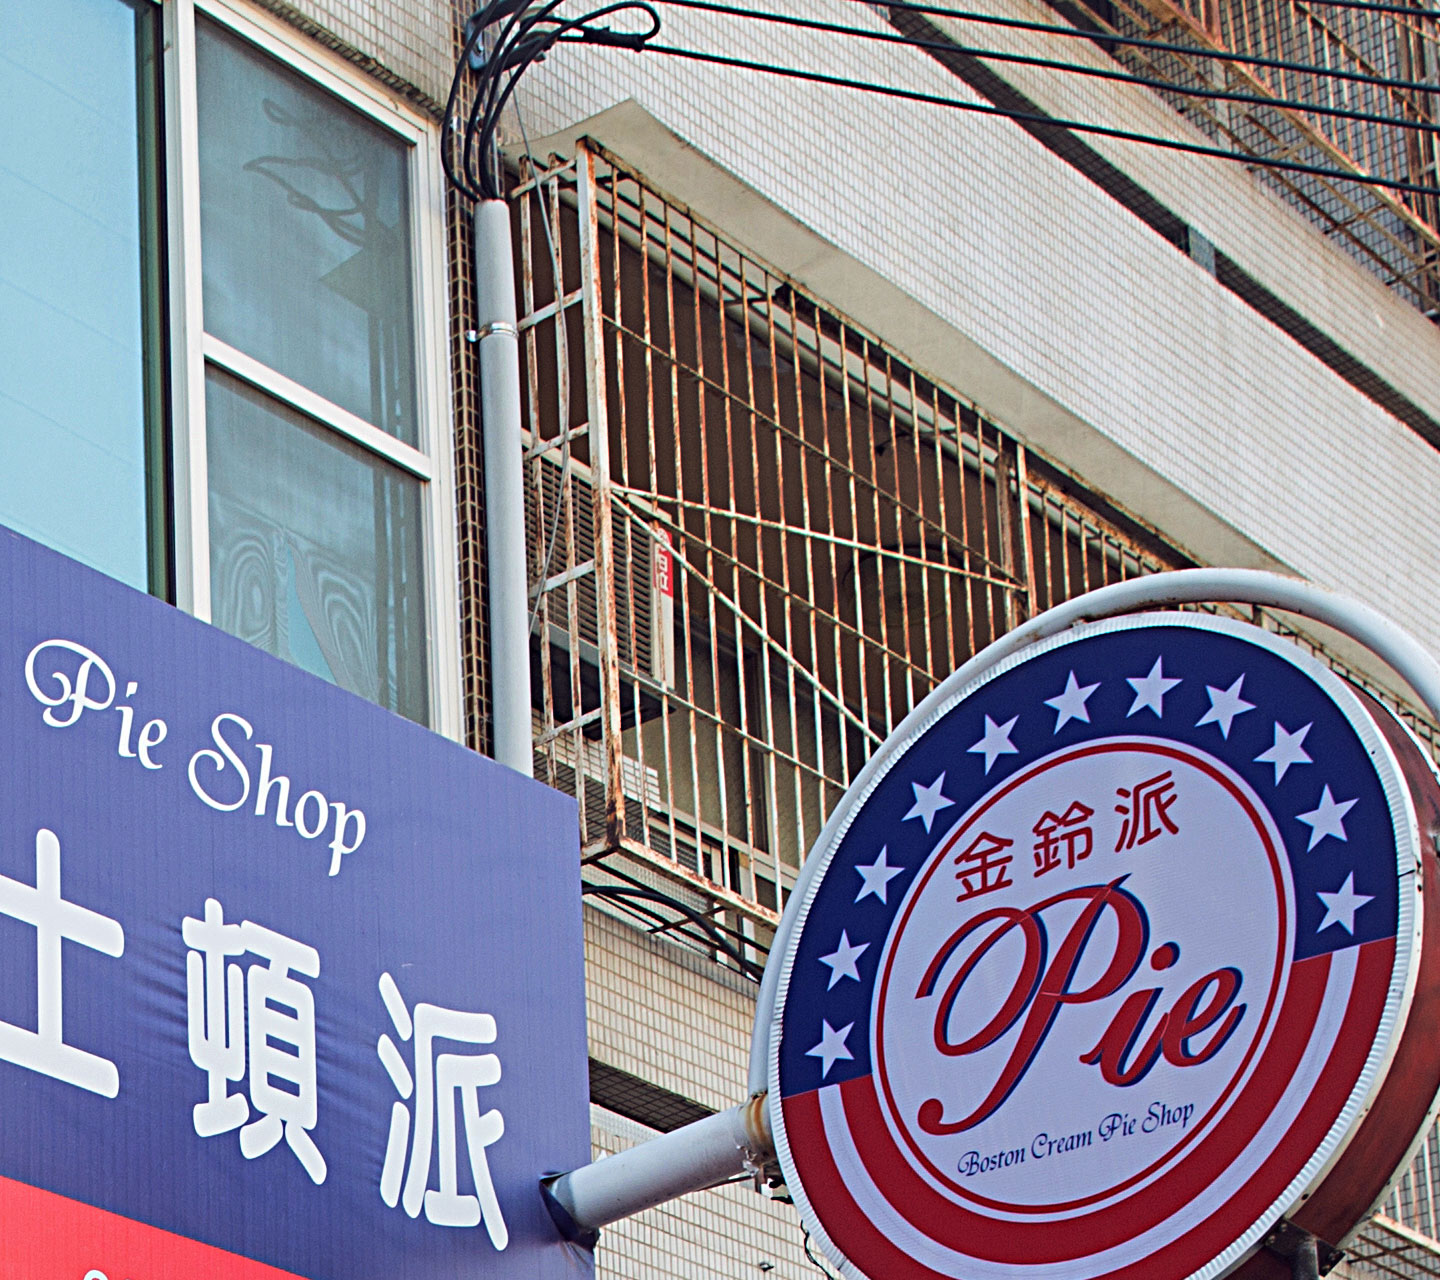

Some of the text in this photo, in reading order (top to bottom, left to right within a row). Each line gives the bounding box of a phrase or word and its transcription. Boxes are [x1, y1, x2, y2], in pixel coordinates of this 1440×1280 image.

[25, 639, 168, 770] Pie
[187, 713, 367, 876] Shop
[952, 770, 1180, 904] 金鈴派
[915, 873, 1247, 1136] Pie
[957, 1101, 1194, 1177] Boston Cream Pie Shop
